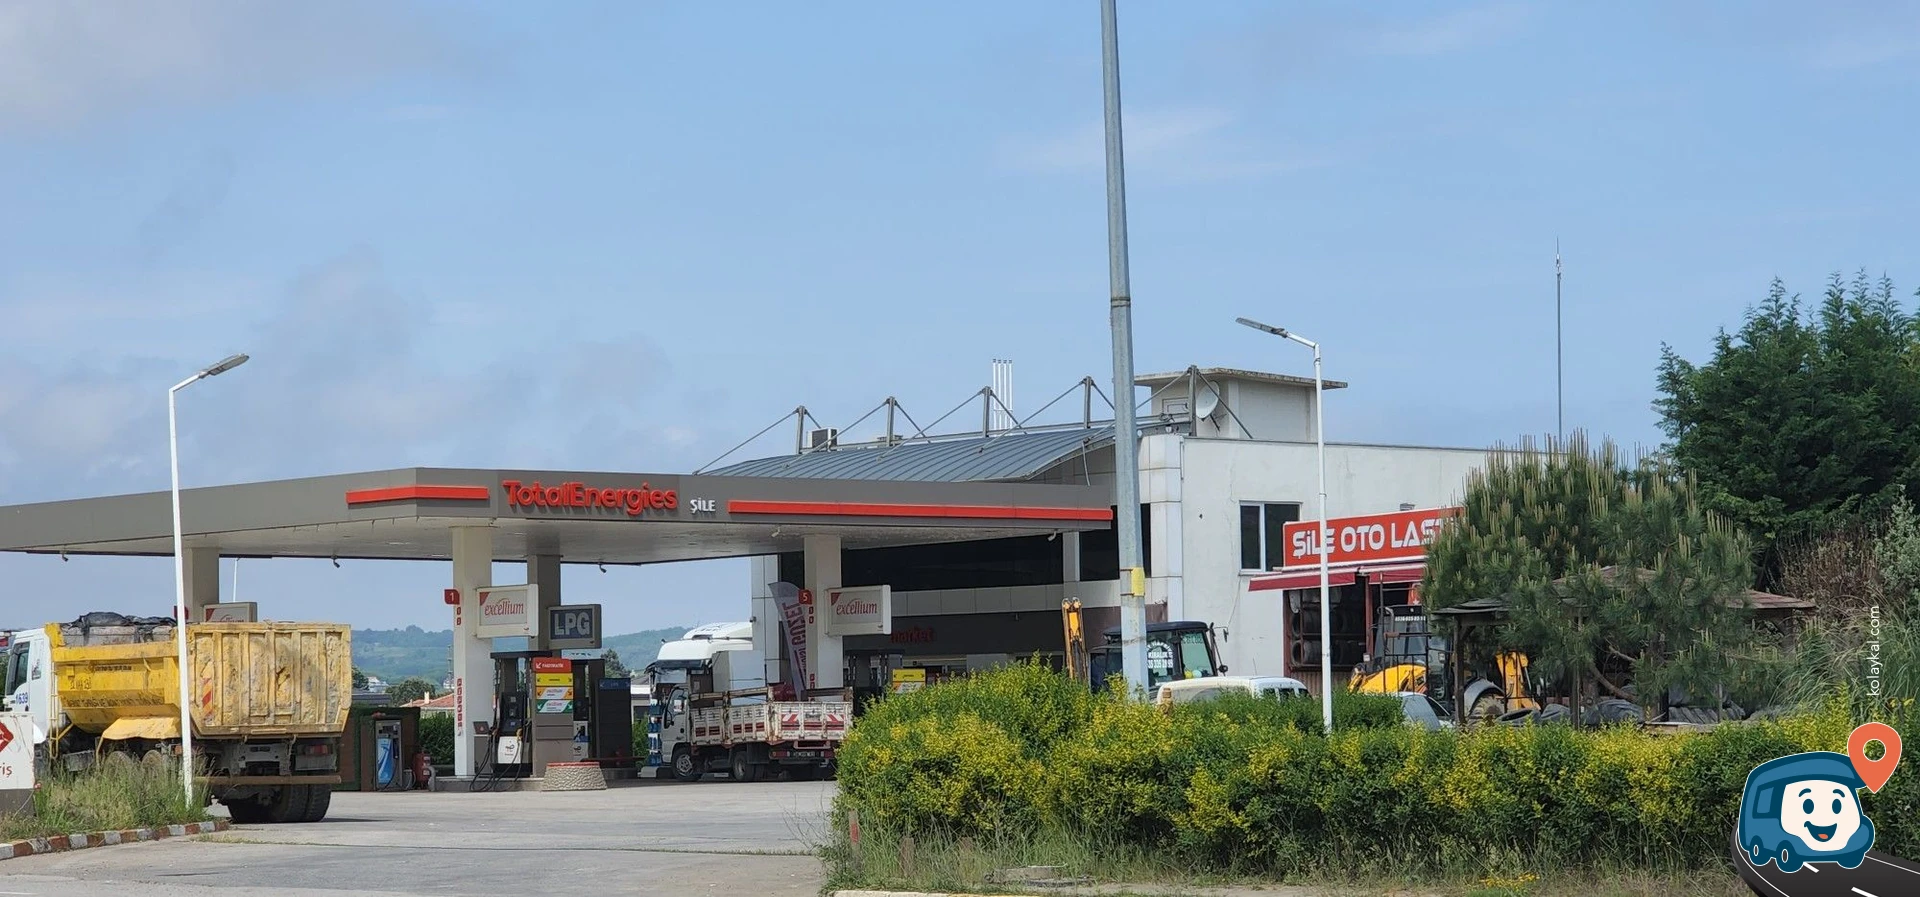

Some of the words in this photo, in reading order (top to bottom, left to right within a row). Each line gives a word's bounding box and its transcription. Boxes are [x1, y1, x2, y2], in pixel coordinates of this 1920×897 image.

[502, 480, 678, 516] TotalEnergies
[1340, 523, 1385, 553] OTO
[484, 600, 524, 617] excellium
[836, 600, 878, 616] excellium
[554, 611, 591, 636] LPG
